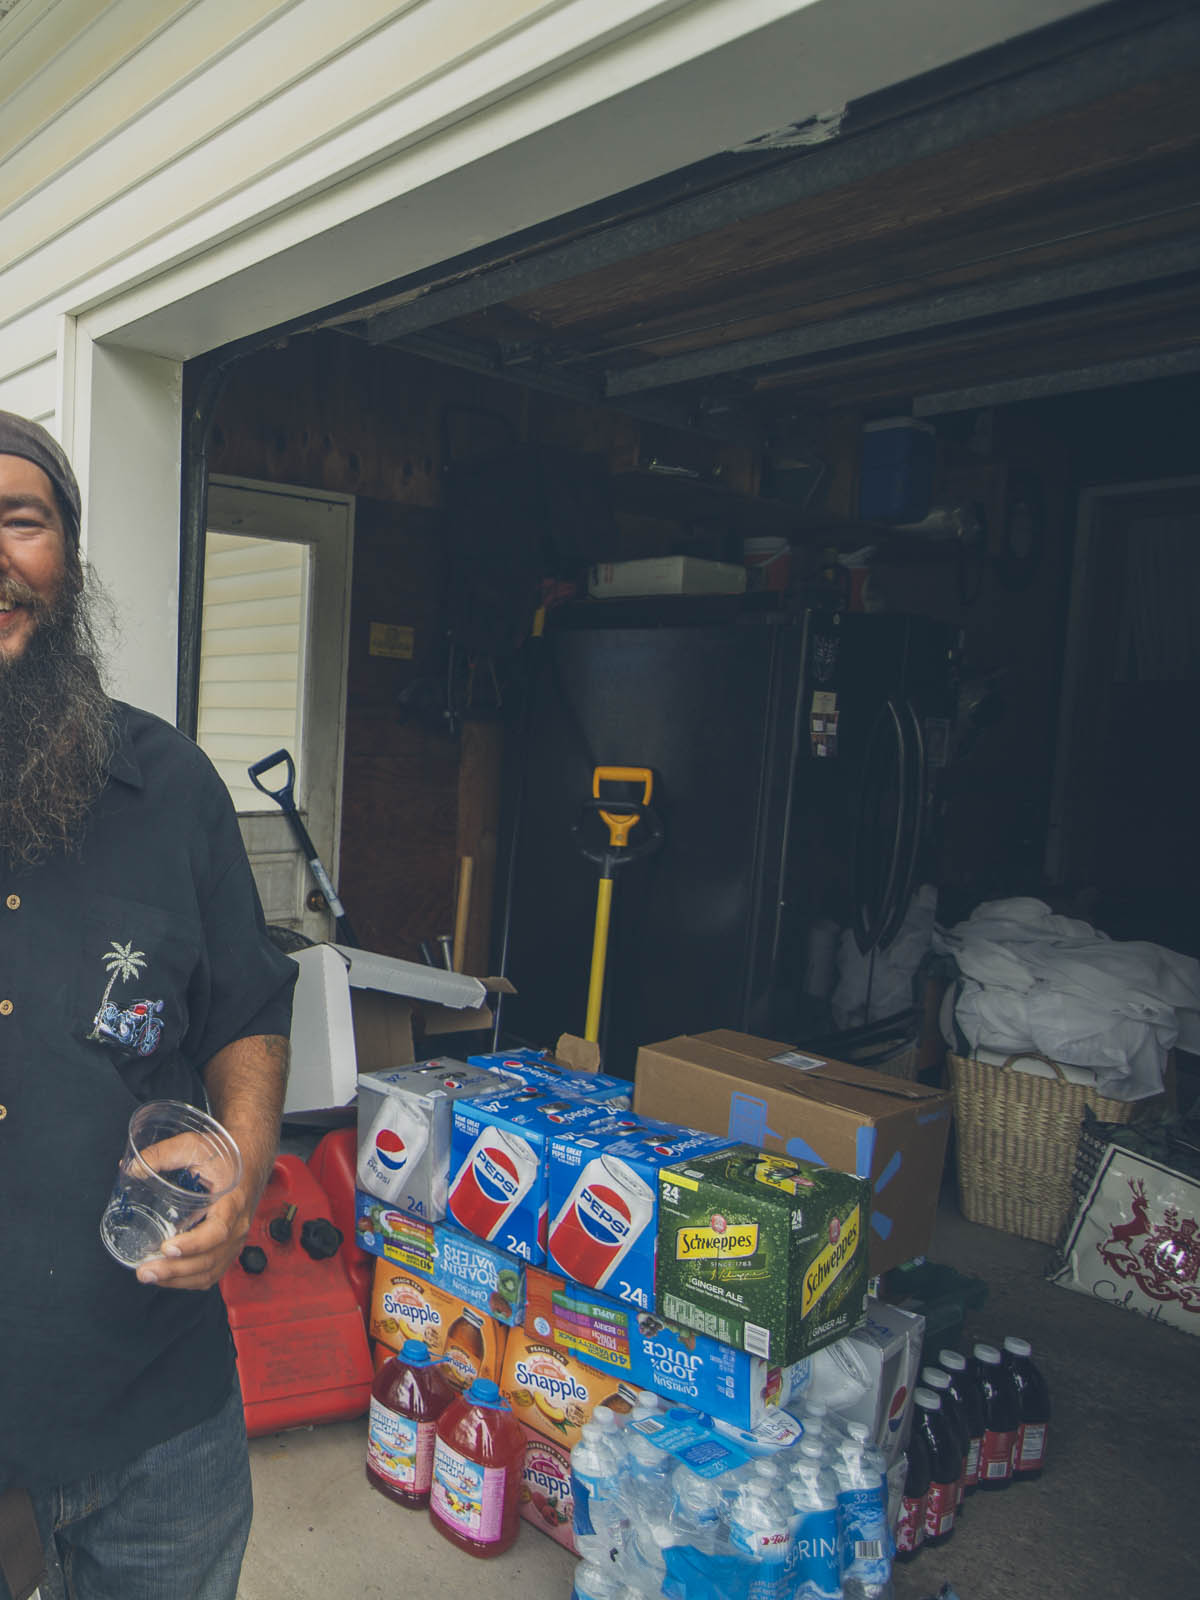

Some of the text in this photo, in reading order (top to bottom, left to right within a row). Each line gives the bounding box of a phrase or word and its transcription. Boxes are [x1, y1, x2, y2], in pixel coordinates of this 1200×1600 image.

[552, 1142, 583, 1157] SAME GREAT
[552, 1149, 566, 1161] PEPSI
[566, 1153, 581, 1167] TASTE
[367, 1158, 391, 1185] pepsi
[476, 1149, 519, 1196] PEPSI
[662, 1182, 680, 1199] 24
[407, 1195, 424, 1216] 24
[580, 1187, 631, 1238] PEPSI
[791, 1210, 802, 1225] 24
[506, 1234, 527, 1260] 24
[682, 1233, 752, 1254] Schweppes
[443, 1244, 497, 1280] WATERS
[806, 1222, 857, 1304] Schweppes
[619, 1281, 642, 1307] 24
[691, 1278, 724, 1296] GINGER
[725, 1290, 744, 1303] ALE
[384, 1294, 440, 1324] Snapple
[593, 1321, 616, 1334] BERRY
[812, 1319, 835, 1337] GINGER
[836, 1312, 847, 1325] ALE
[529, 1345, 548, 1355] PEACH
[610, 1351, 628, 1365] 40
[642, 1339, 704, 1371] JUICE
[516, 1361, 587, 1401] Snapple
[651, 1357, 696, 1382] 100%
[854, 1493, 868, 1504] 32
